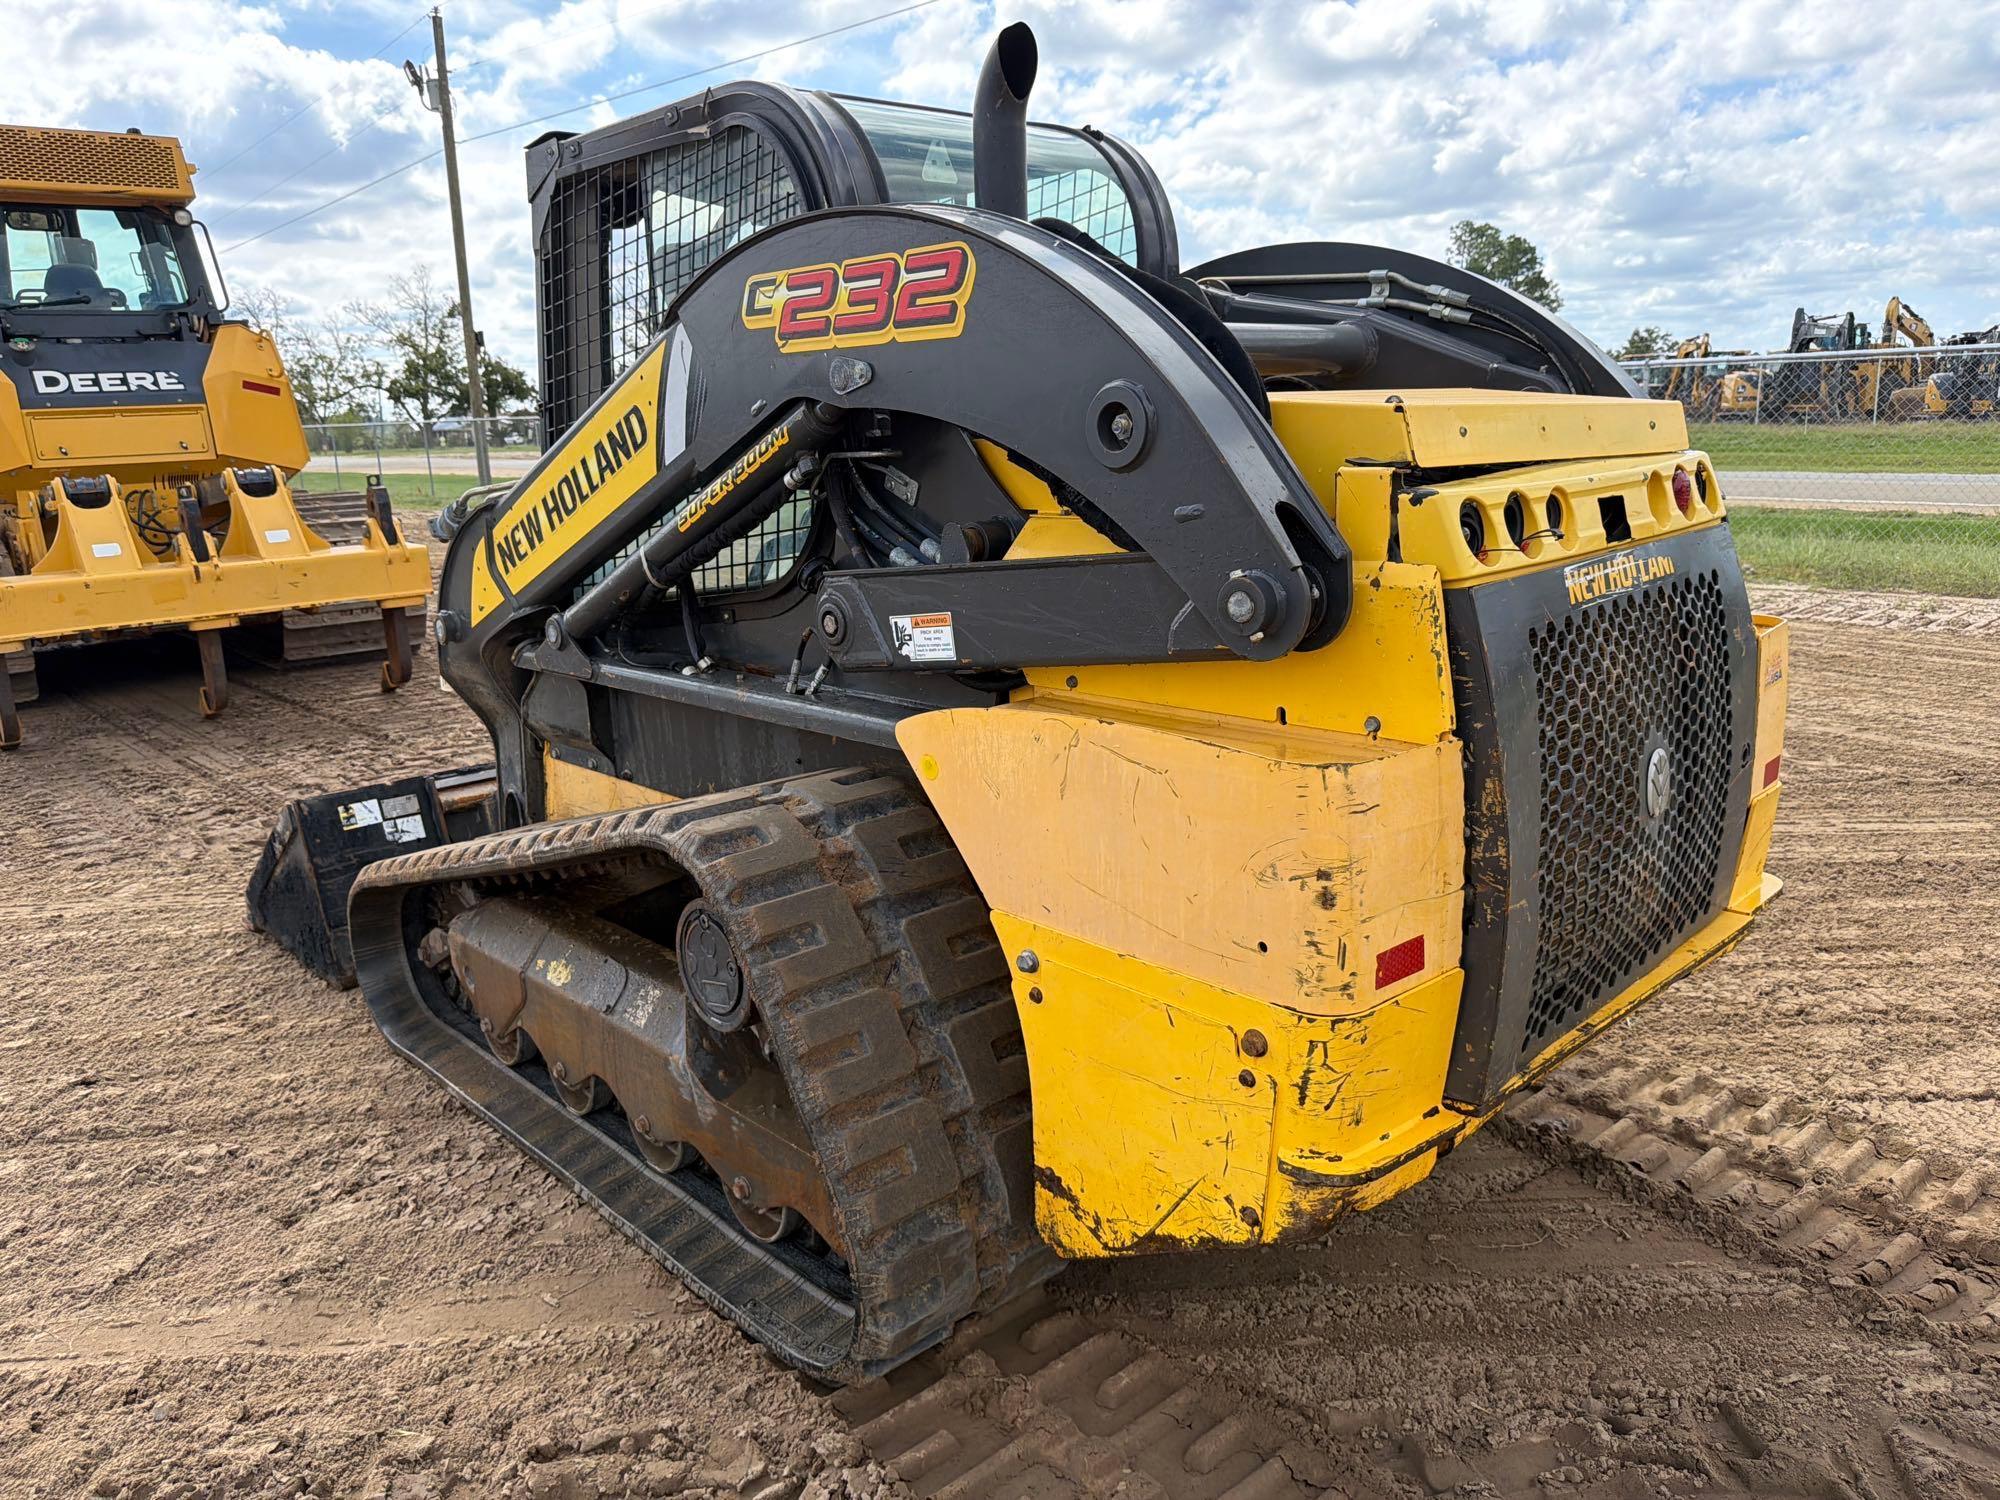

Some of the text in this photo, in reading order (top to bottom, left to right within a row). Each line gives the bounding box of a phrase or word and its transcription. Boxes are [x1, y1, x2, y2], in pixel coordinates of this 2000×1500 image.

[743, 243, 974, 350] C232
[32, 370, 185, 394] DEERE
[496, 404, 648, 575] NEW HOLLAND
[678, 425, 790, 533] SUPER BOOM
[920, 617, 948, 625] WARNING
[1566, 562, 1607, 605] NEW
